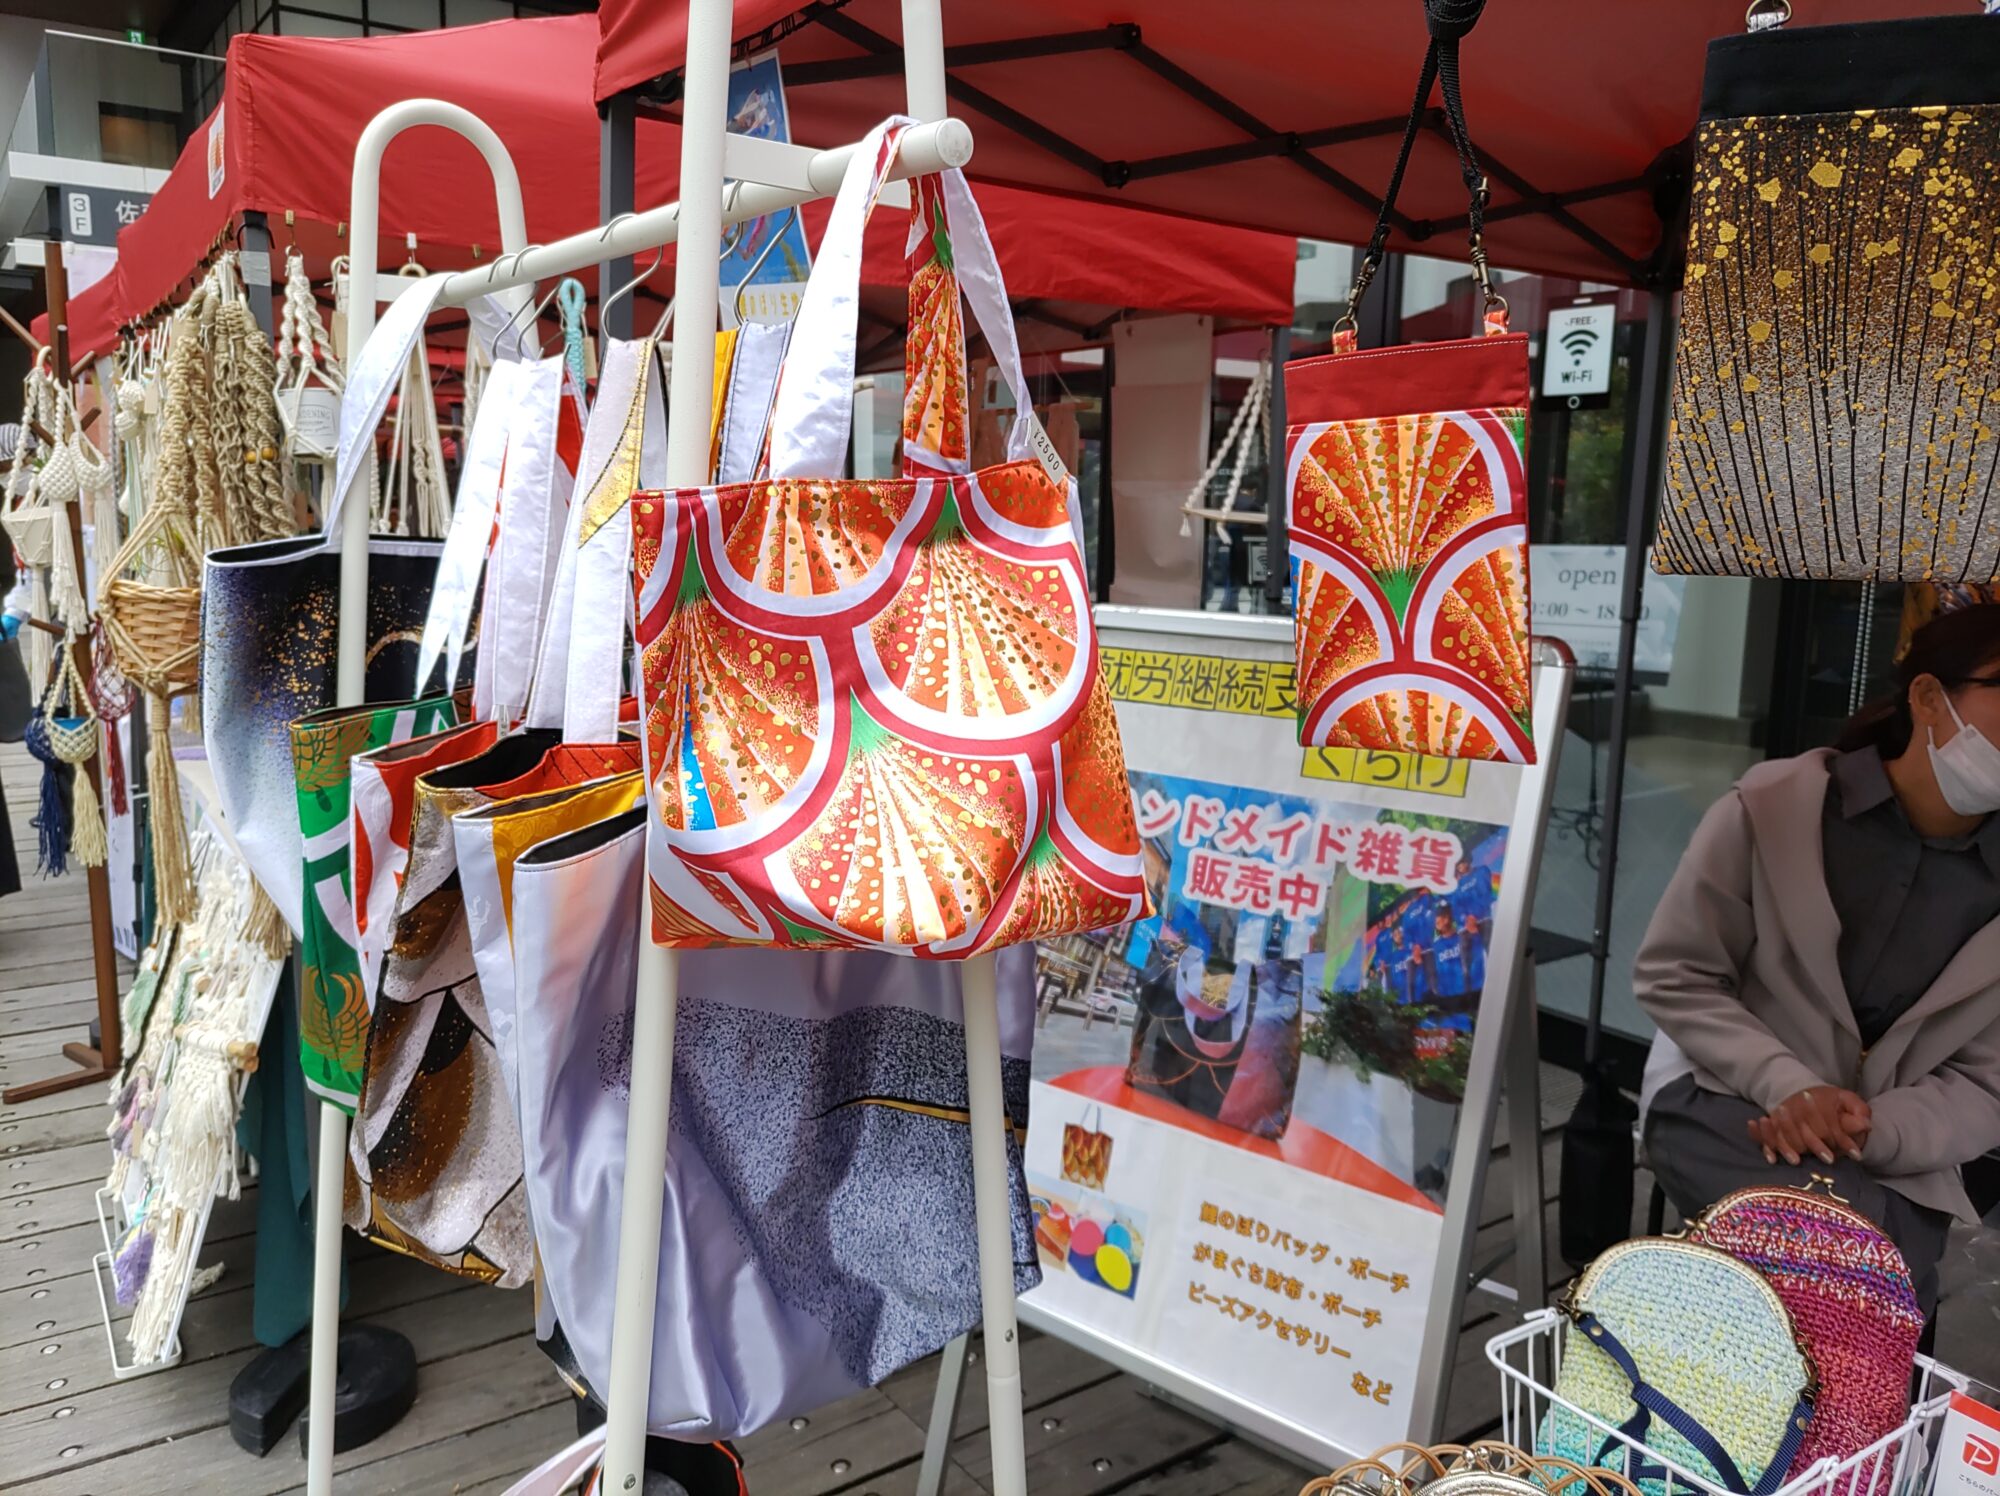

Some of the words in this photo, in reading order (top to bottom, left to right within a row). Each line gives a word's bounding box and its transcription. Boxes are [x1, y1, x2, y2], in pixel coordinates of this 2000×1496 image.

[1570, 316, 1592, 326] FREE
[1561, 370, 1593, 383] Wi-Fi
[1558, 568, 1617, 591] open
[1189, 854, 1320, 917] 販売中
[1188, 1281, 1352, 1360] ビーズアクセサリー
[1351, 1371, 1394, 1406] など
